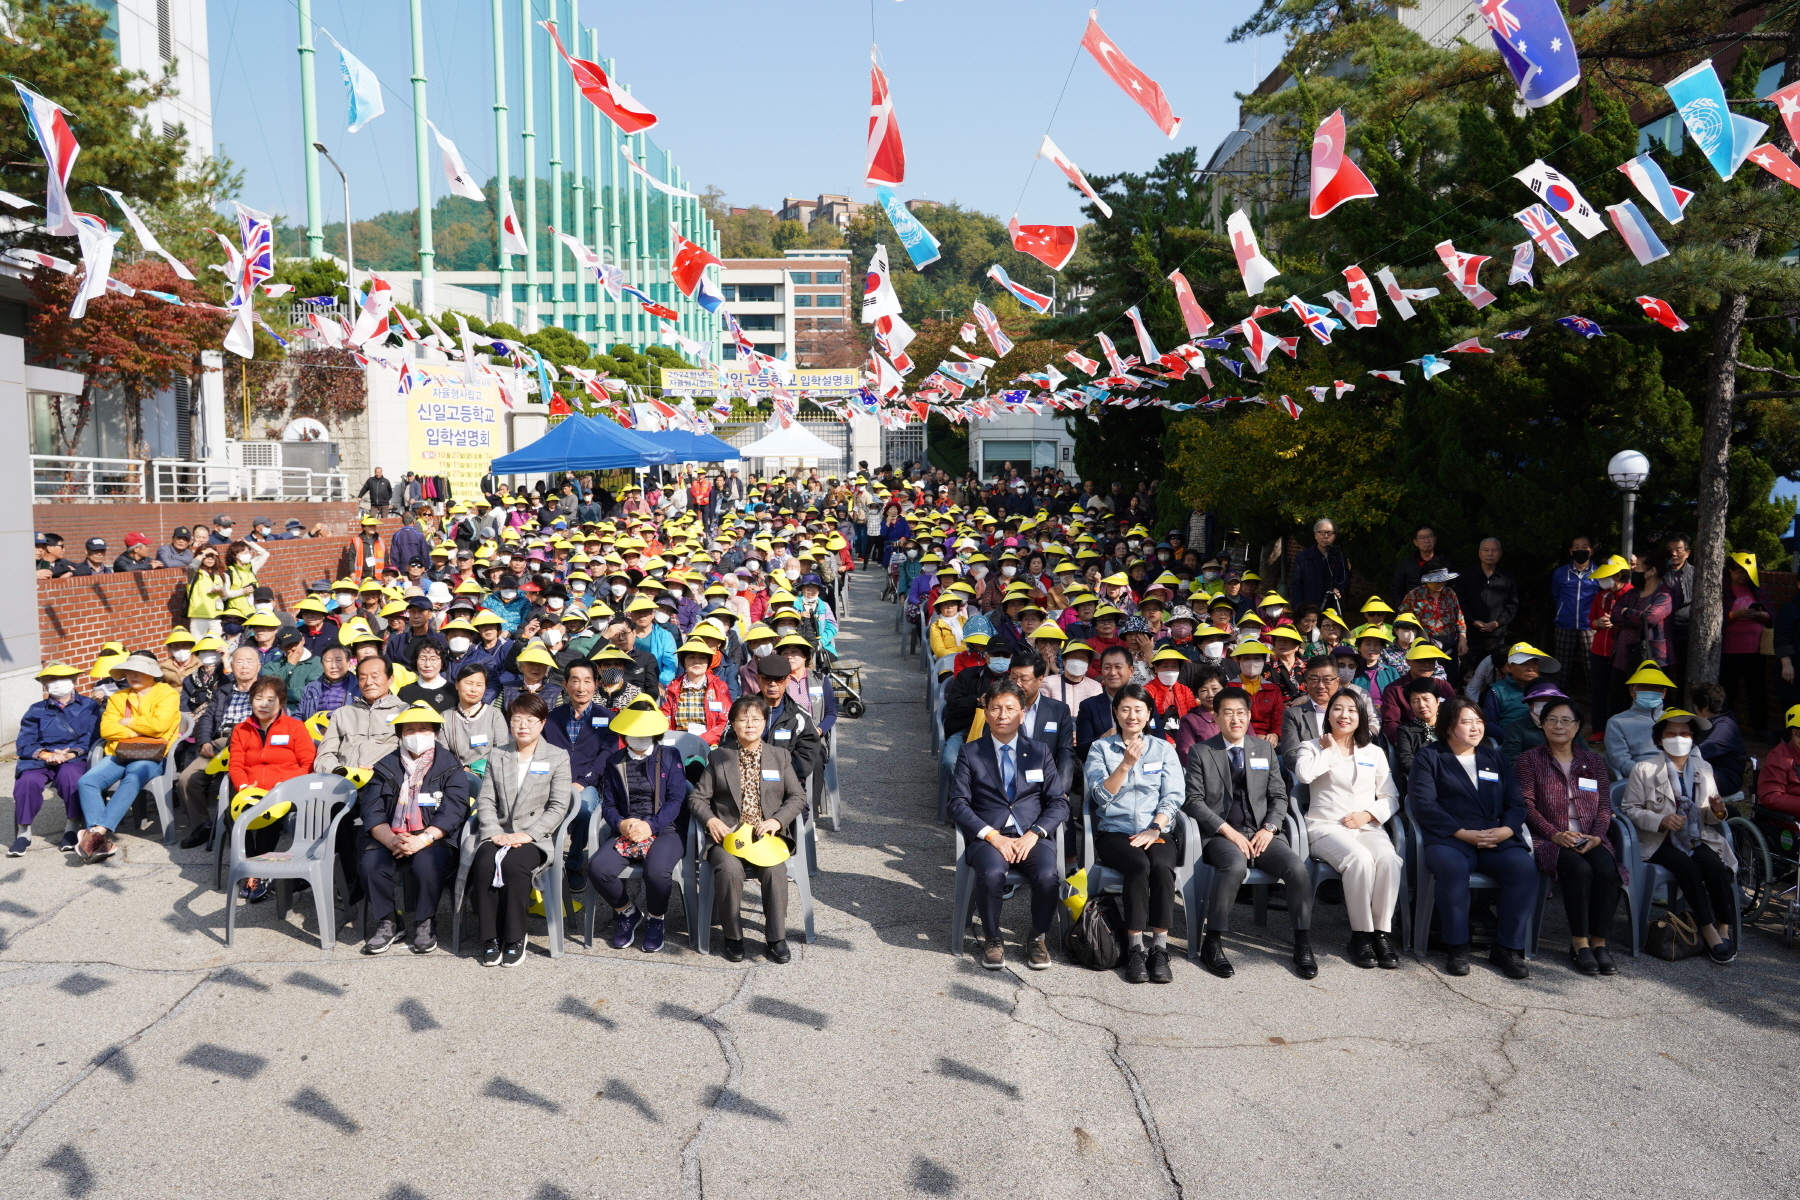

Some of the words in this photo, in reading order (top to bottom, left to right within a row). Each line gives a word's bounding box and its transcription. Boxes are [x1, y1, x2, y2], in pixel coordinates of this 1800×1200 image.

[716, 371, 797, 389] 일고등학
[800, 374, 854, 388] 입학설명회
[432, 387, 483, 401] 자율형사립고
[417, 403, 496, 423] 신일고등학교
[426, 429, 490, 447] 입학설명회
